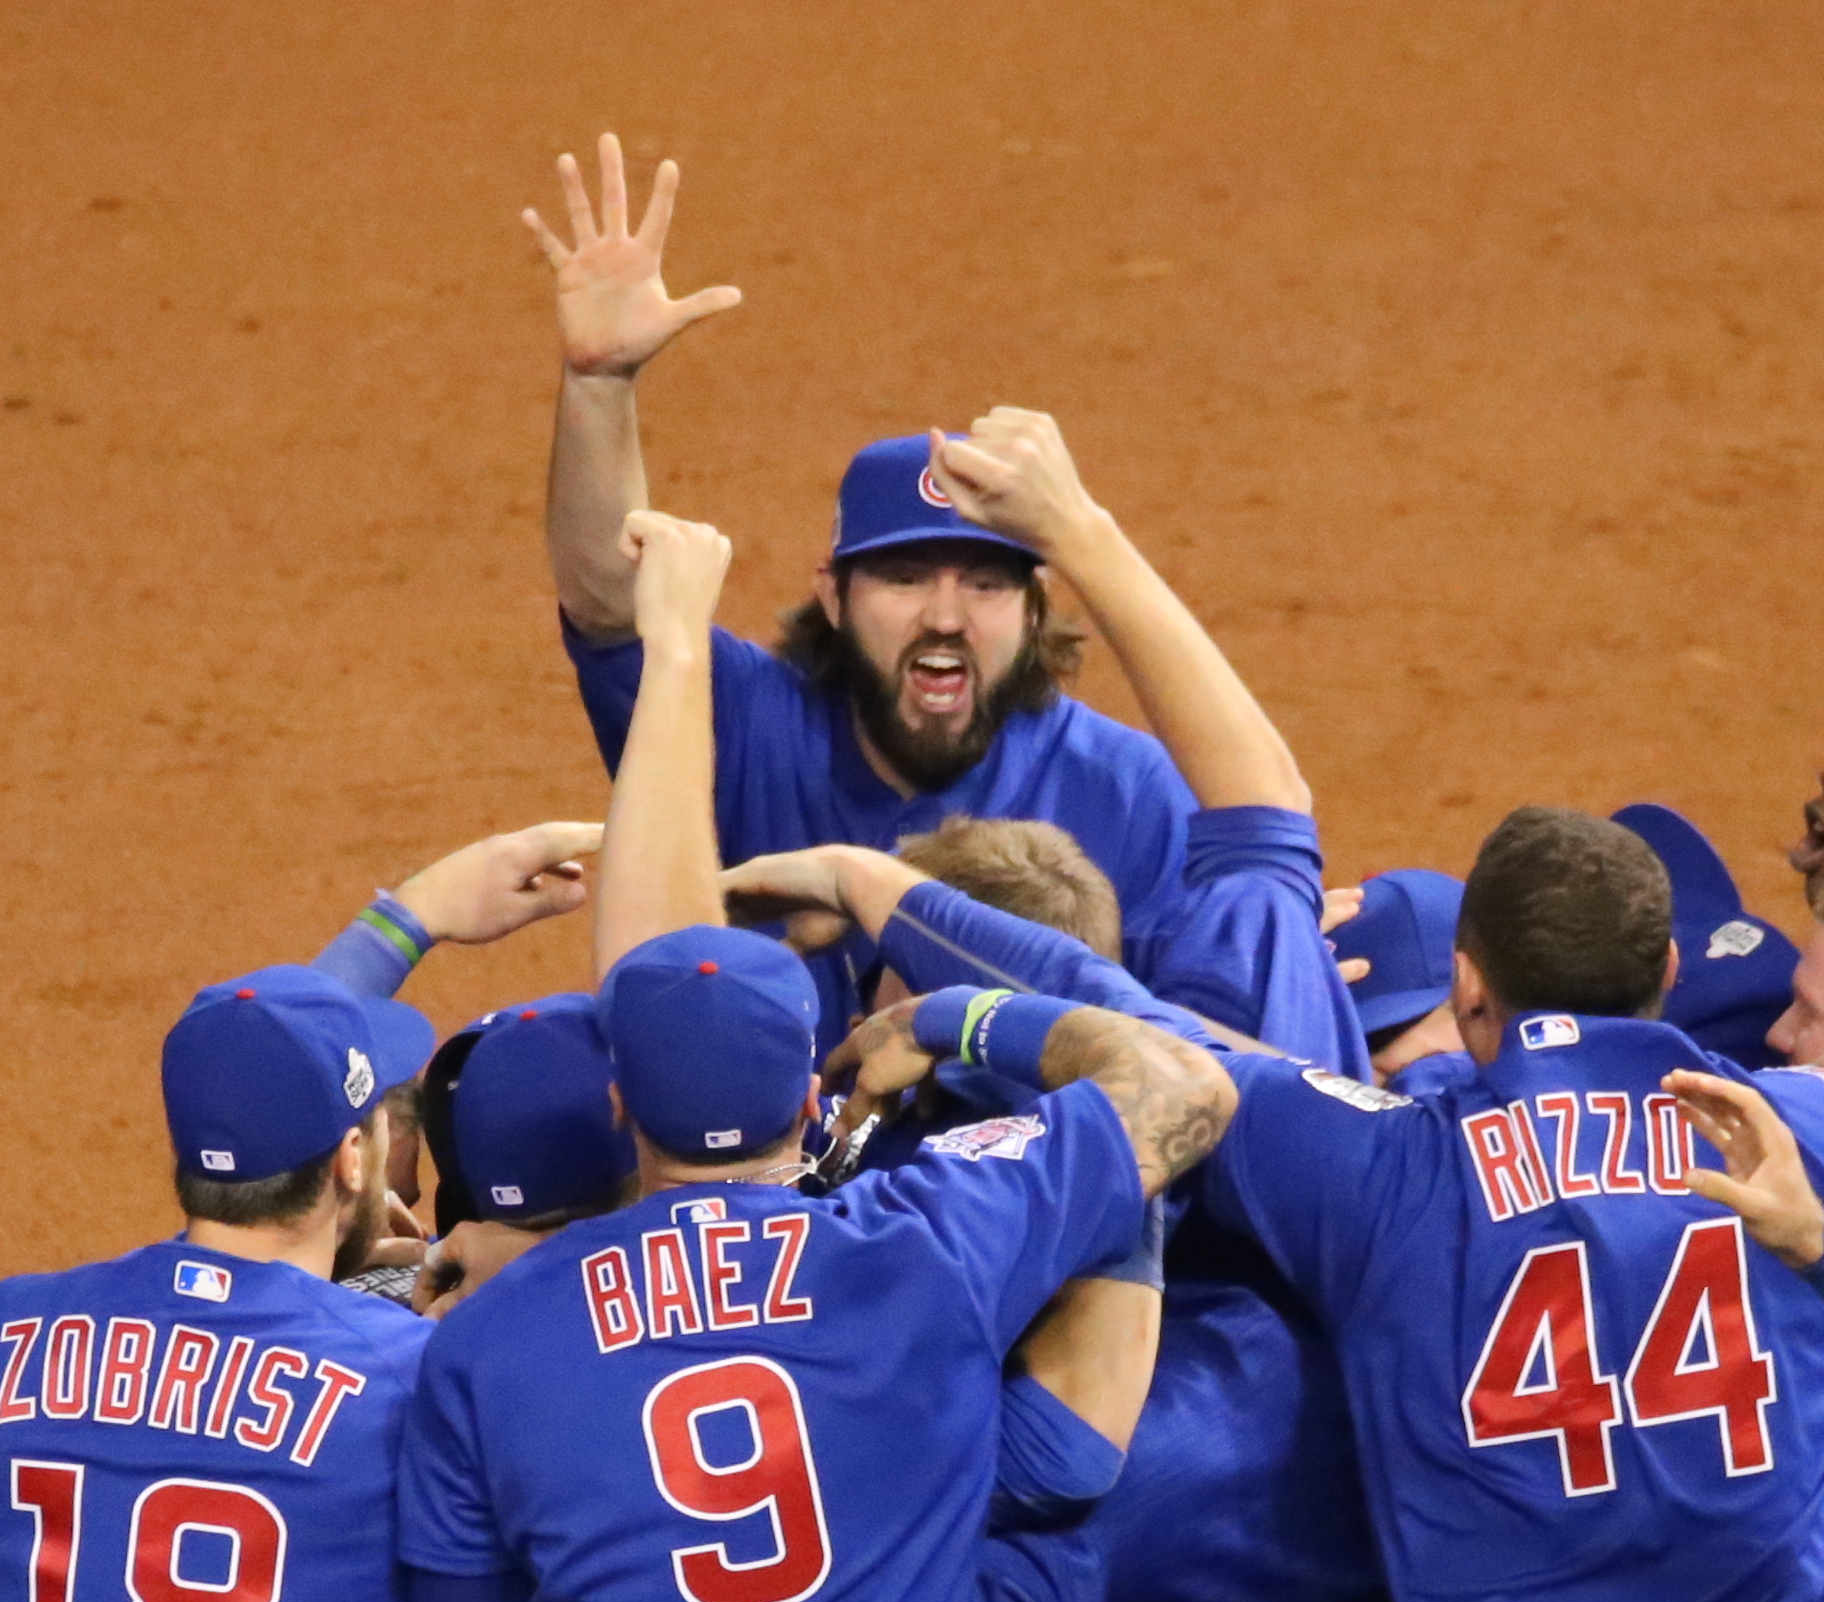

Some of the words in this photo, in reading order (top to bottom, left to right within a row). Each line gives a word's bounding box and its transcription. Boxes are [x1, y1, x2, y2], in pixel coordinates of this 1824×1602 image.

[1461, 1090, 1695, 1223] RIZZO
[581, 1212, 813, 1354] BAEZ
[1461, 1216, 1778, 1497] 44
